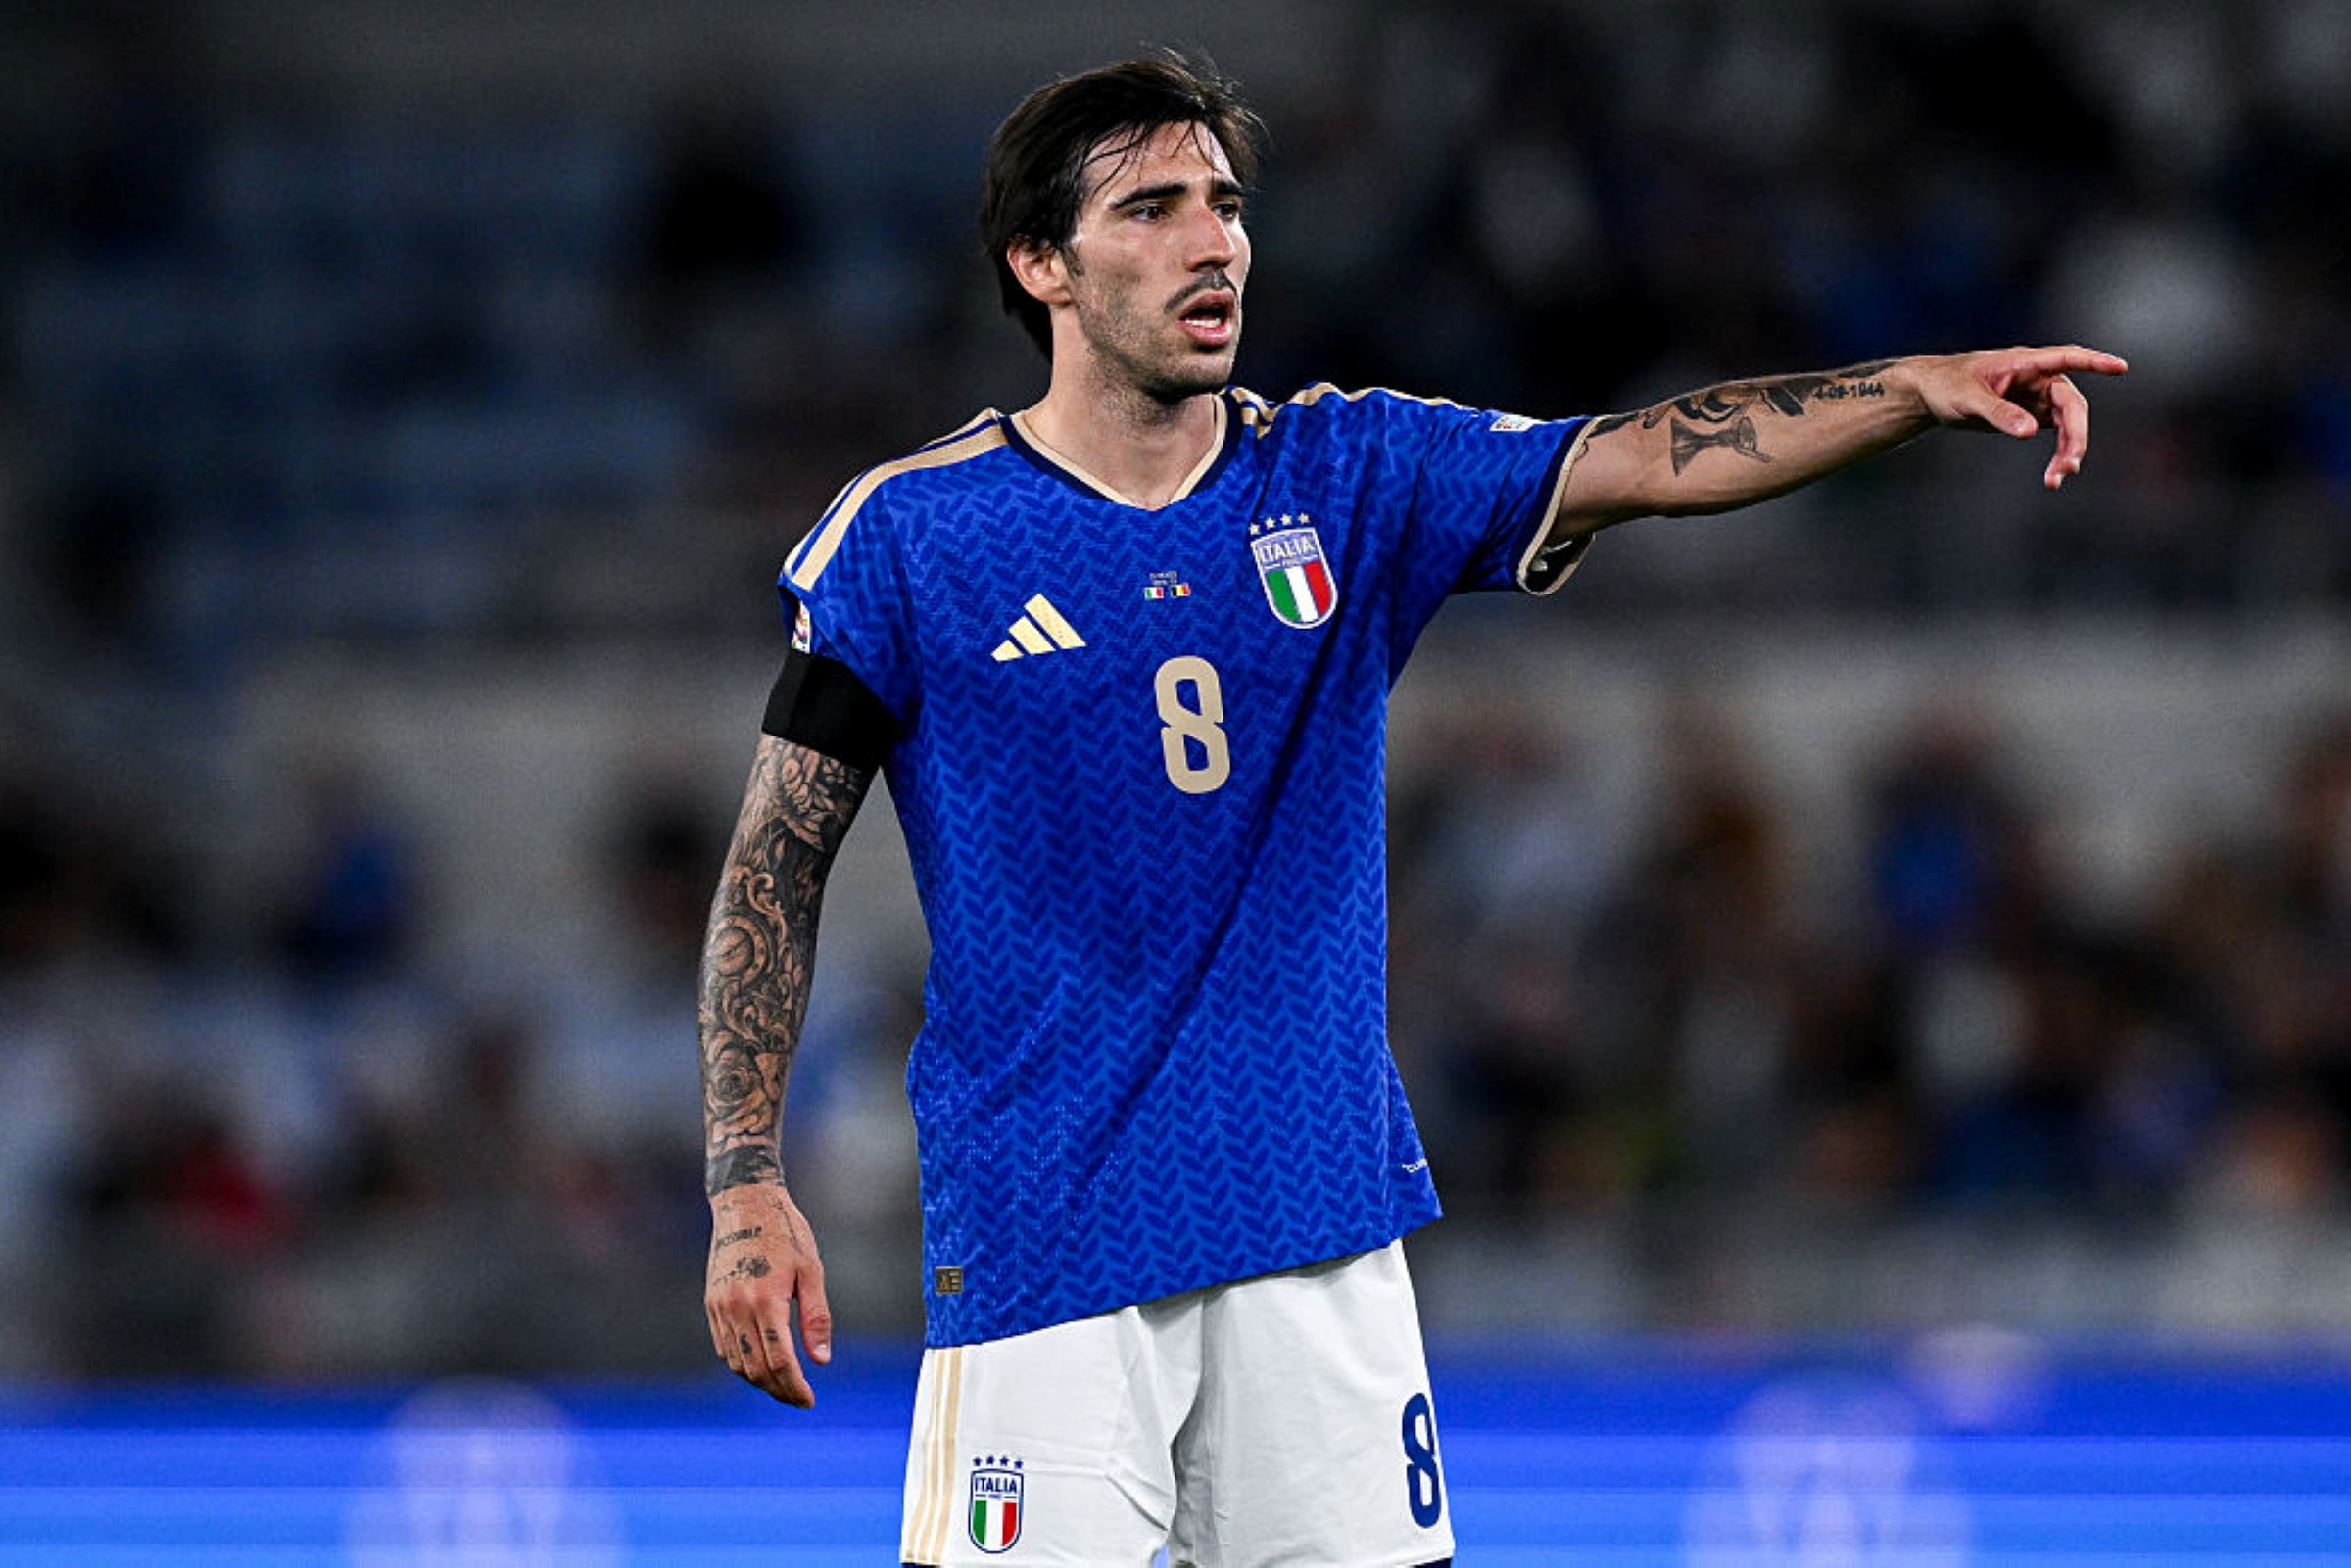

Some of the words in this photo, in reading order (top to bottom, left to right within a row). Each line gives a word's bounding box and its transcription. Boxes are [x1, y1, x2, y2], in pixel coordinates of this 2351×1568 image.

[1258, 535, 1316, 563] ITALIA
[1154, 655, 1230, 795] 8
[974, 1477, 1018, 1495] ITALIA
[1402, 1392, 1441, 1528] 8
